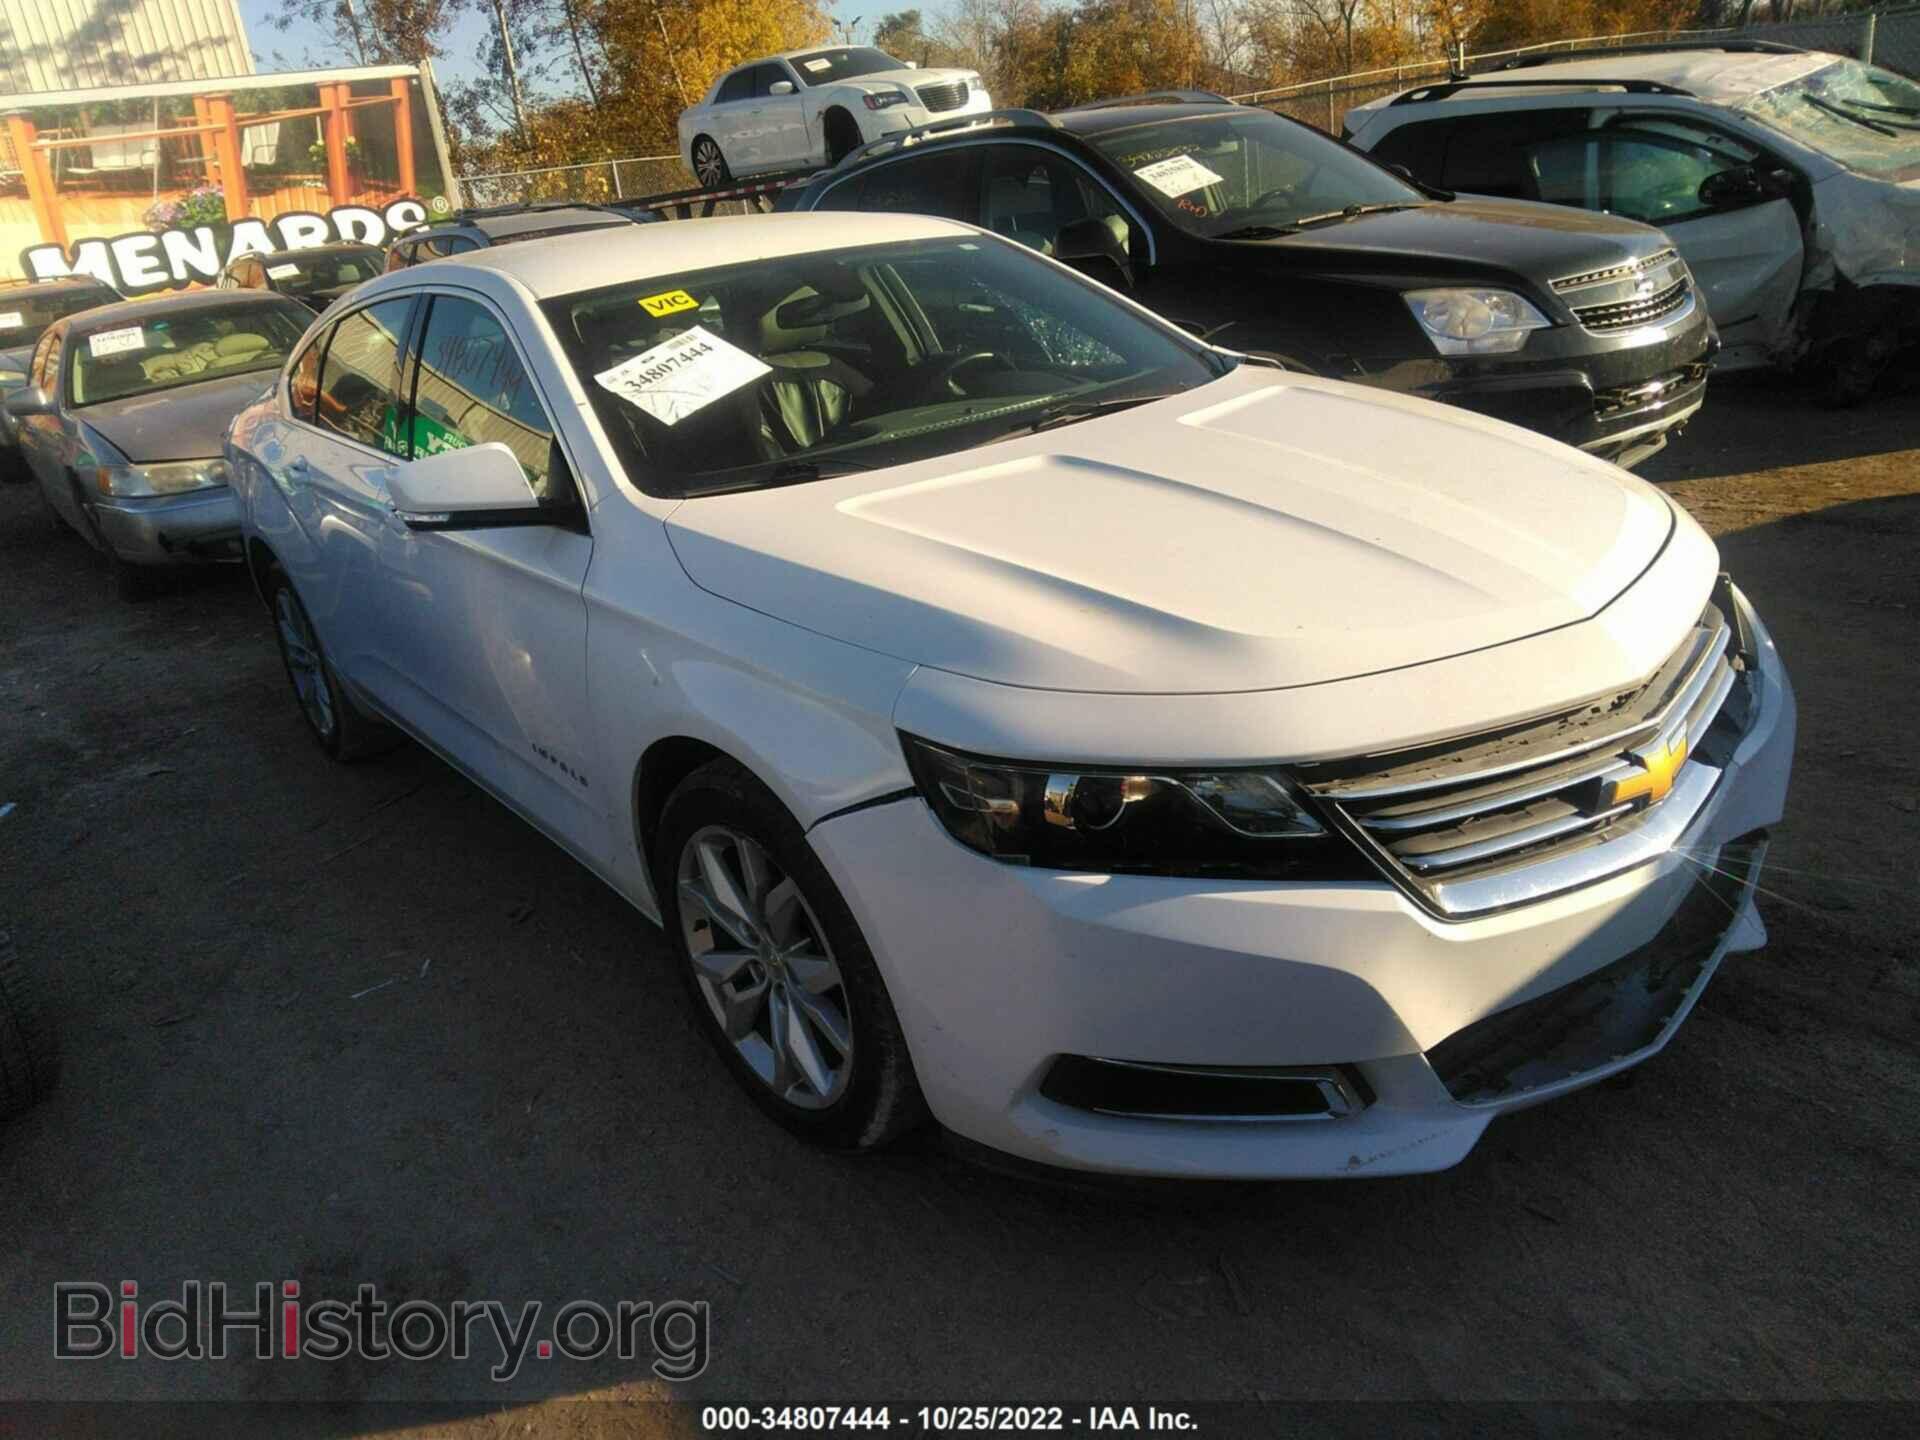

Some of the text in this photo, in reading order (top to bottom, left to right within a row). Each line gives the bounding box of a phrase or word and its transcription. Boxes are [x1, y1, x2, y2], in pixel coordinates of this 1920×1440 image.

[26, 200, 432, 289] MENARDS
[645, 294, 689, 311] VIC
[624, 341, 713, 392] 34807444
